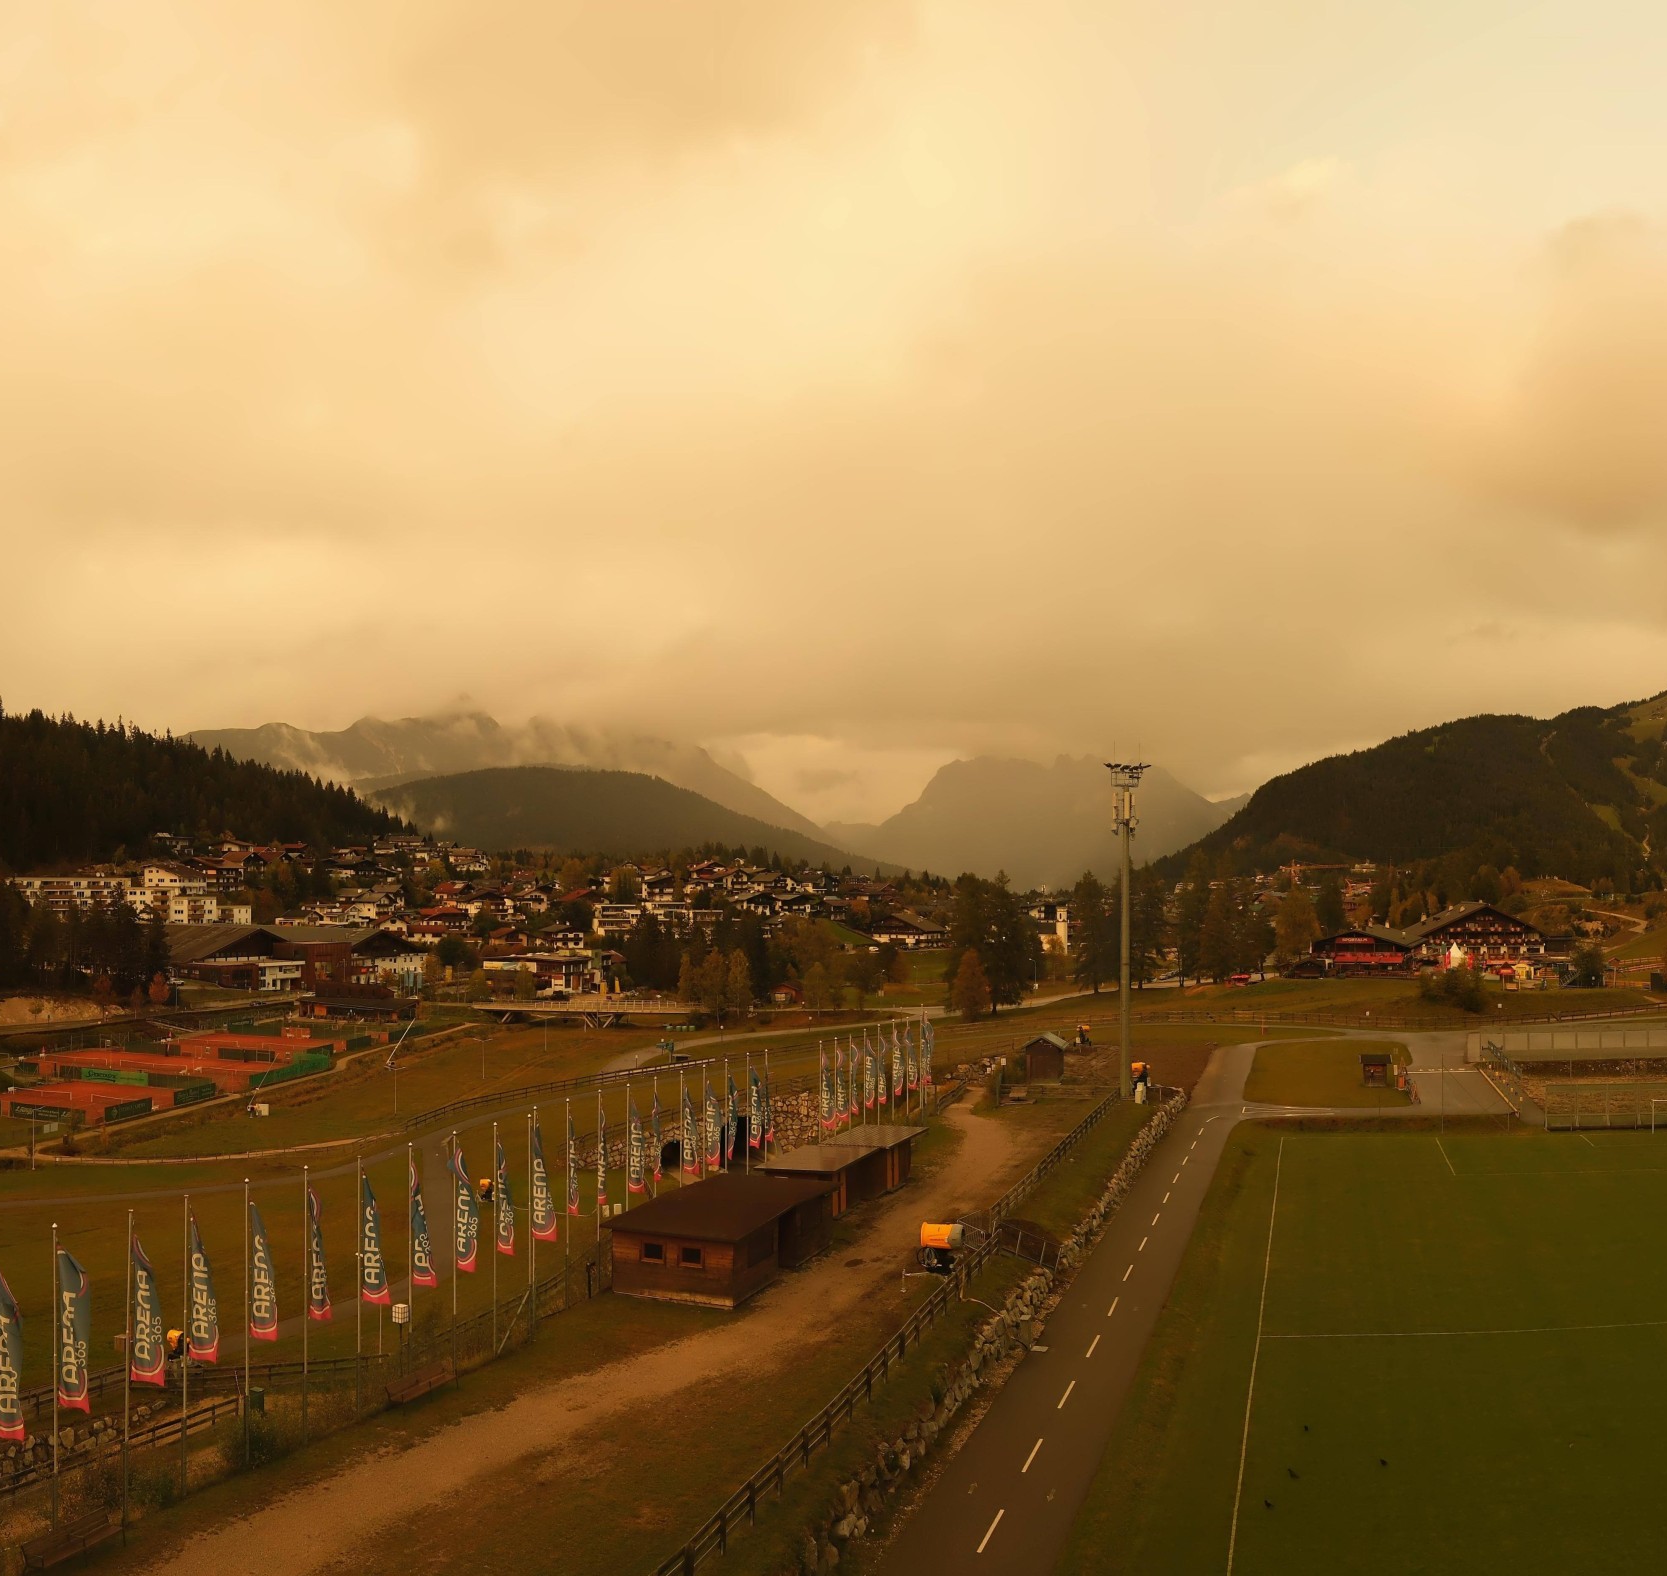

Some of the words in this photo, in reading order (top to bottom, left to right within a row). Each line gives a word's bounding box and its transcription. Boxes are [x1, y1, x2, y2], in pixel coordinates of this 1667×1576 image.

[467, 1217, 478, 1238] 365
[191, 1253, 209, 1339] ARENA
[135, 1269, 150, 1360] ARENA
[208, 1298, 217, 1324] 365
[151, 1316, 162, 1343] 365
[74, 1340, 87, 1368] 365
